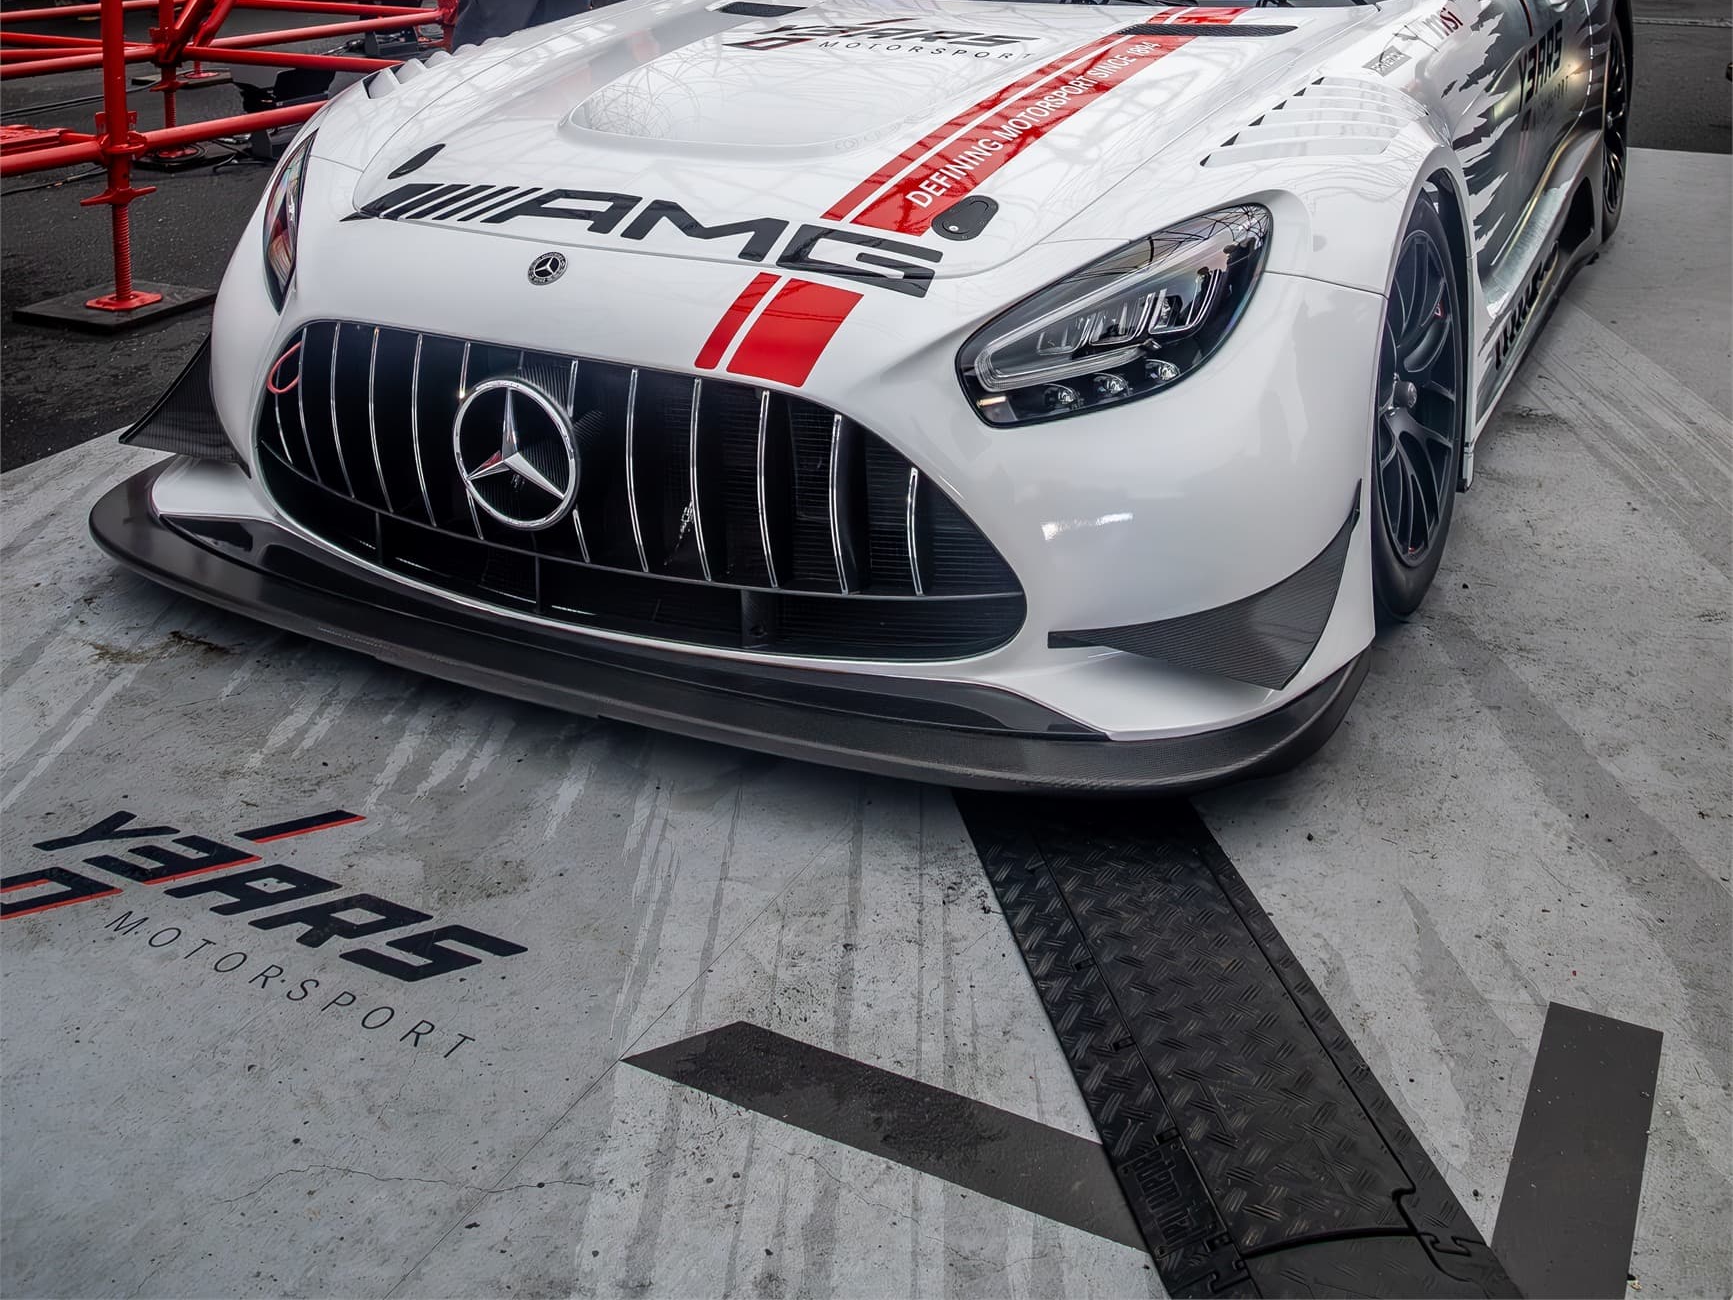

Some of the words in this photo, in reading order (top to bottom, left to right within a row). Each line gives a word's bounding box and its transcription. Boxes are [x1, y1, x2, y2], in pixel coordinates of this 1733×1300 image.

[819, 40, 1036, 60] MOTORSPORT
[905, 138, 1004, 208] DEFINING
[992, 74, 1099, 143] MOTORSPORT
[1088, 53, 1137, 79] SINCE
[1126, 41, 1162, 58] 1894
[484, 187, 944, 298] AMG
[105, 910, 475, 1059] MOTORSPORT
